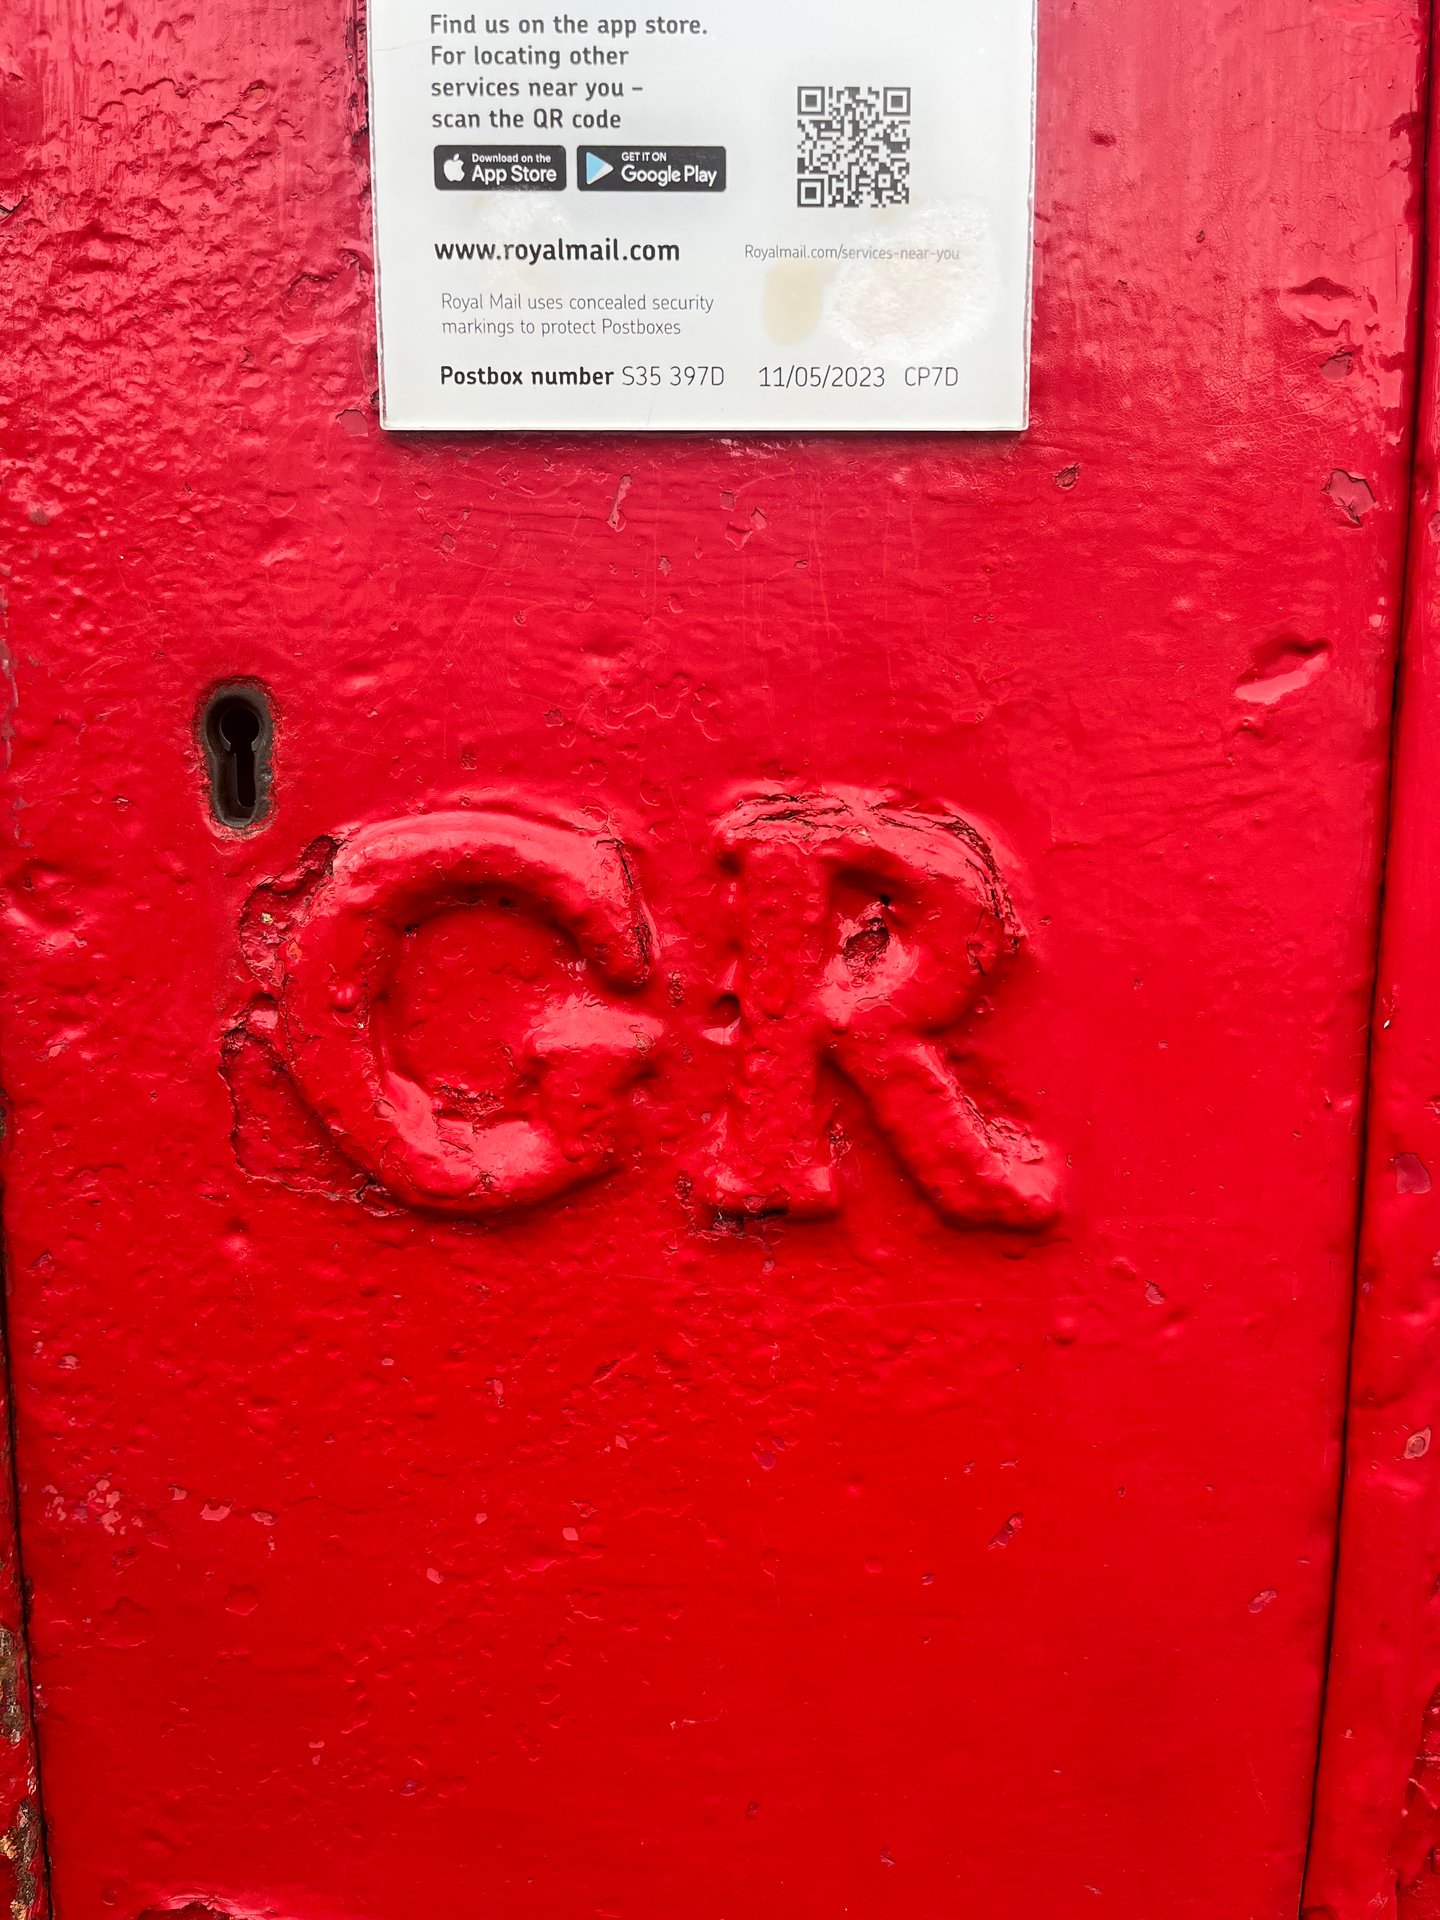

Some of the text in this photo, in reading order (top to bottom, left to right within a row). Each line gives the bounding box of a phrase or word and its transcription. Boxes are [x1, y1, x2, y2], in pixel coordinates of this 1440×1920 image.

[430, 14, 708, 38] Find us on the app store.
[431, 46, 630, 68] For locating other
[431, 77, 520, 97] services
[528, 81, 578, 96] near
[585, 81, 624, 100] you
[431, 108, 622, 130] scan the QR code
[471, 153, 551, 163] Download on the
[621, 152, 667, 162] GET IT ON
[471, 165, 557, 185] App Store
[621, 166, 718, 187] Google Play
[434, 238, 680, 265] www.royalmail.com
[744, 244, 960, 262] Royalmail.com/services-near-you
[441, 293, 714, 313] Royal Mail uses concealed security
[442, 318, 681, 337] markings to protect Postboxes
[440, 366, 959, 389] Postbox number S35 397D 11/05/2023 CP7D
